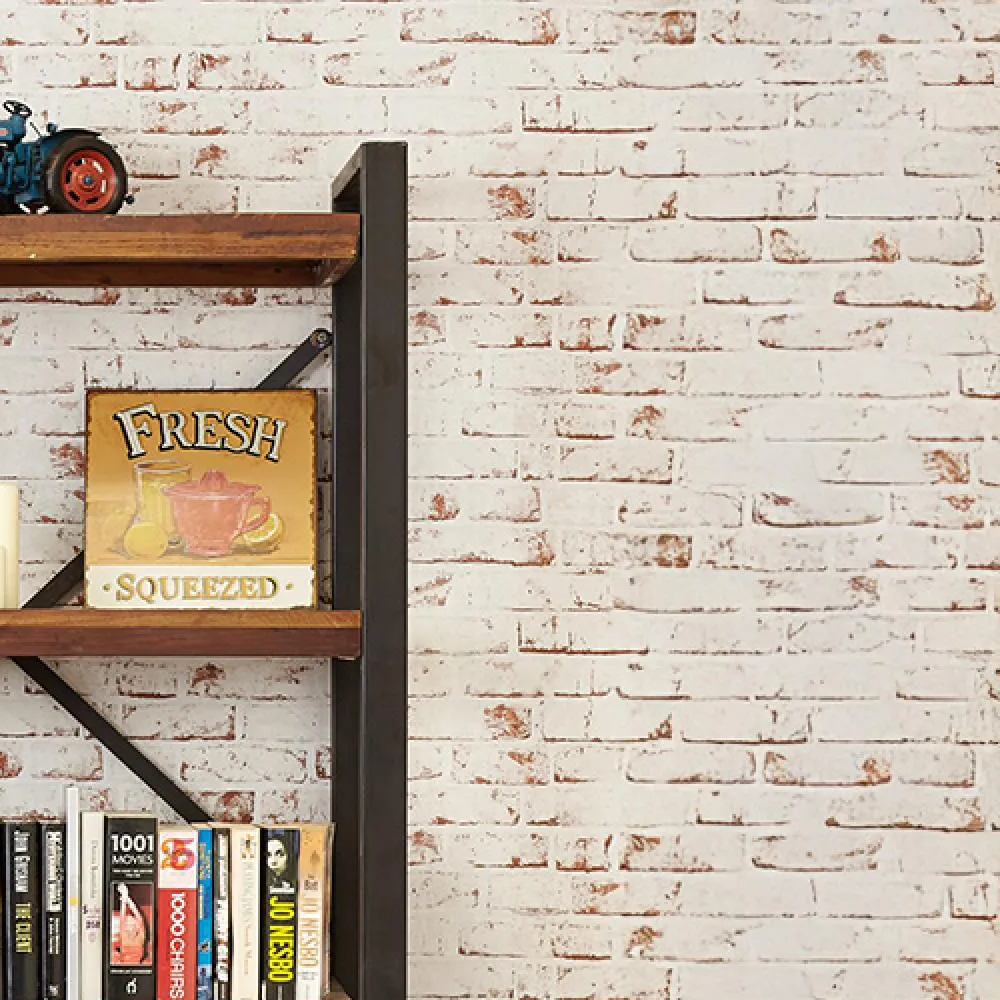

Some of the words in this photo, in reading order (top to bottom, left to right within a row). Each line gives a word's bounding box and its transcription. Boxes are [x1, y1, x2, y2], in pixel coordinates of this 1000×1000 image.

[112, 403, 287, 463] FRESH
[116, 572, 278, 604] SQUEEZED
[112, 834, 153, 852] 1001
[112, 855, 153, 865] MOVIES
[15, 902, 31, 920] THE
[169, 892, 187, 937] 1000
[268, 896, 294, 920] JO
[268, 925, 294, 982] NESBO
[300, 918, 319, 967] NESBO
[169, 938, 187, 999] CHAIRS
[217, 943, 229, 983] CLUB
